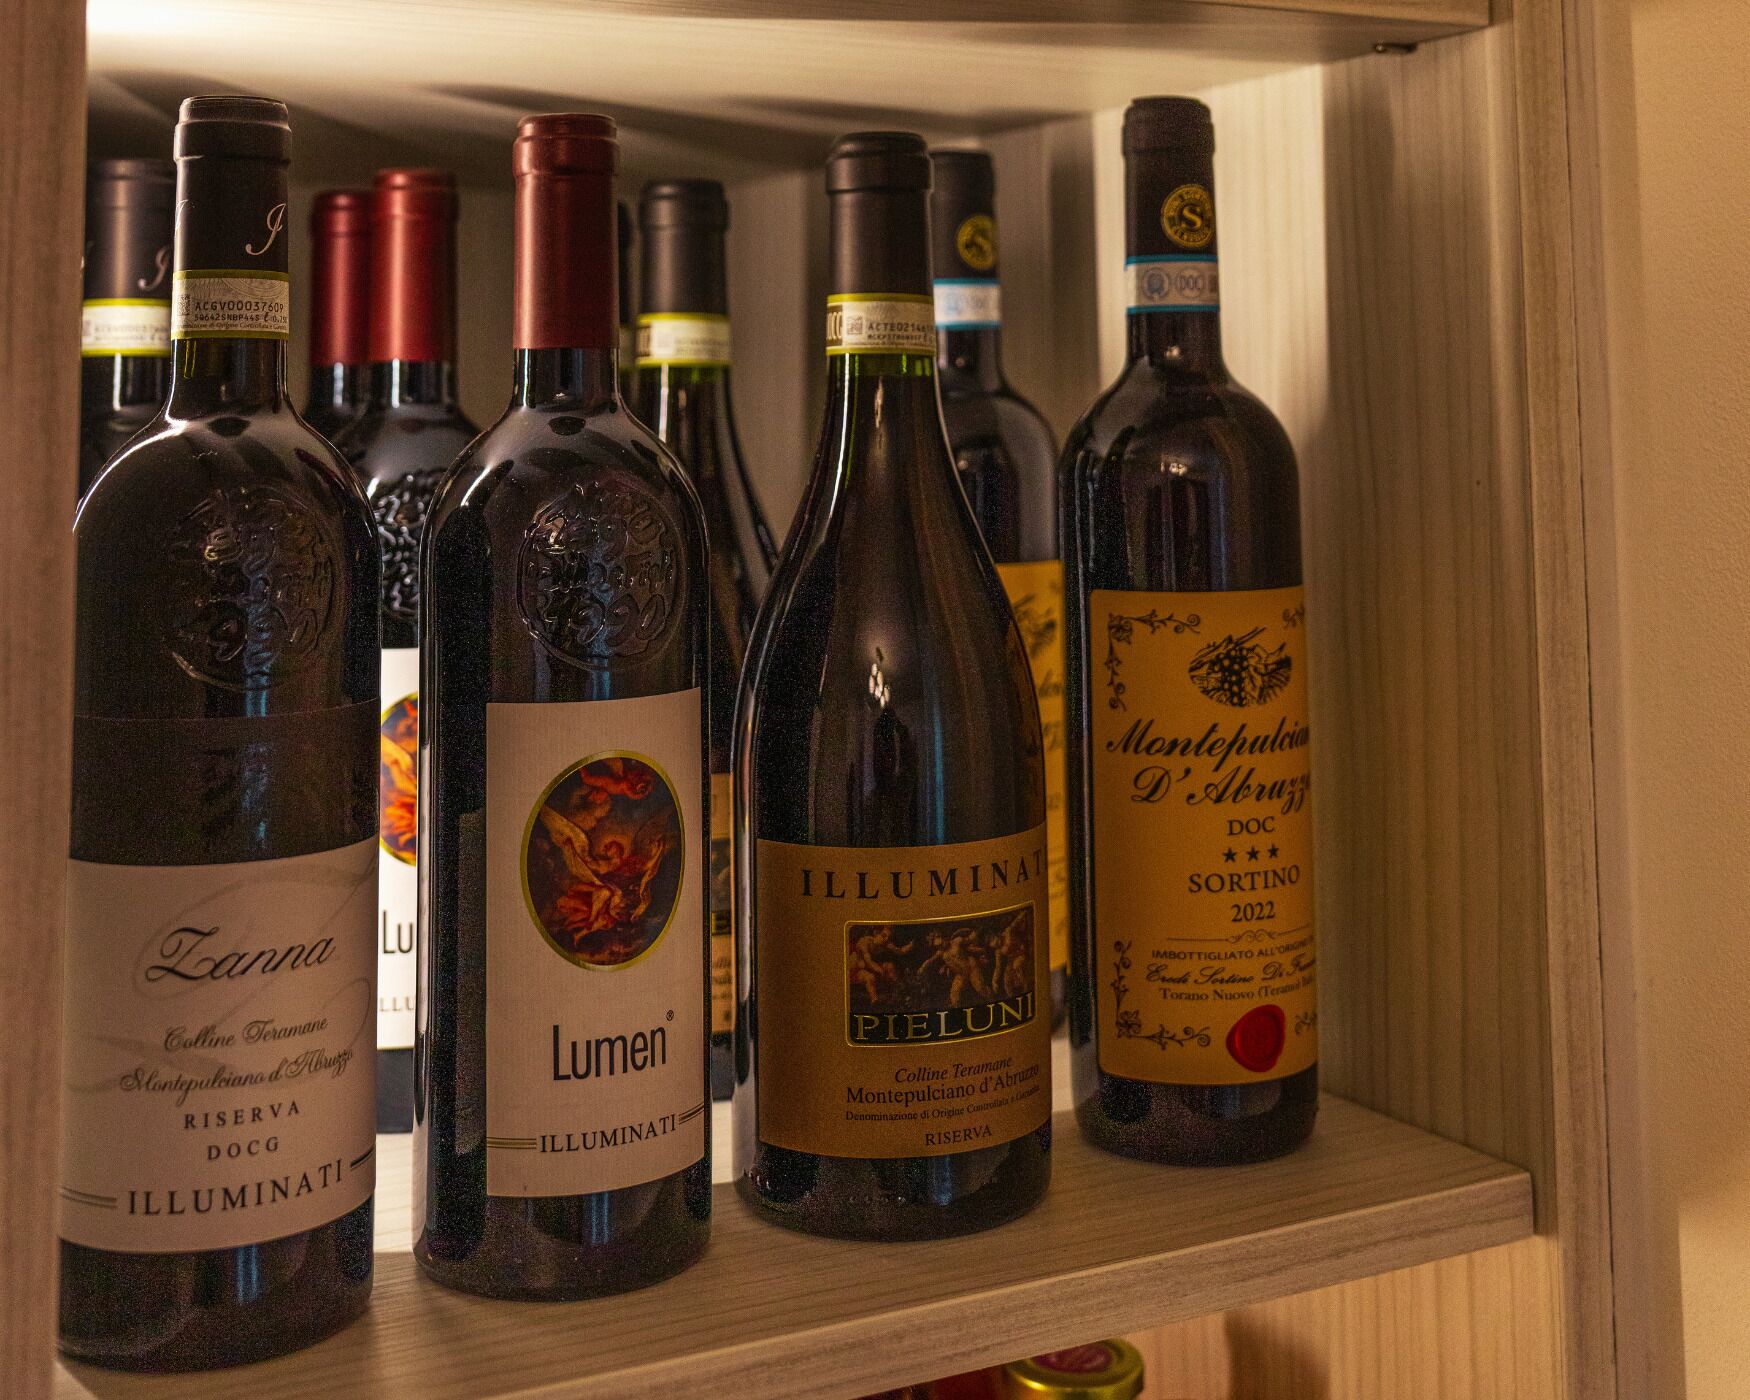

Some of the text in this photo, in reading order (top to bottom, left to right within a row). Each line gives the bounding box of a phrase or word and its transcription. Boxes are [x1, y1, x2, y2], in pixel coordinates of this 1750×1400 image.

[1227, 816, 1275, 836] DOC
[1188, 864, 1300, 894] SORTINO
[1231, 901, 1275, 922] 2022
[145, 926, 335, 983] Zanna
[1152, 949, 1253, 960] IMBOTTIGLIATO
[1159, 987, 1208, 1000] Torano
[1213, 989, 1254, 1000] Nuovo
[853, 991, 1033, 1041] PIELUNI
[164, 1017, 328, 1051] Colline Teramane
[895, 1057, 1012, 1083] Colline Teramane
[120, 1065, 265, 1107] Montepulciano
[847, 1085, 975, 1107] Montepulciano
[184, 1100, 300, 1129] RISERVA
[846, 1110, 918, 1121] Denominazione
[540, 1113, 676, 1152] ILLUMINATI
[925, 1125, 993, 1146] RISERVA
[207, 1136, 279, 1161] DOCG
[129, 1159, 342, 1215] ILLUMINATI
